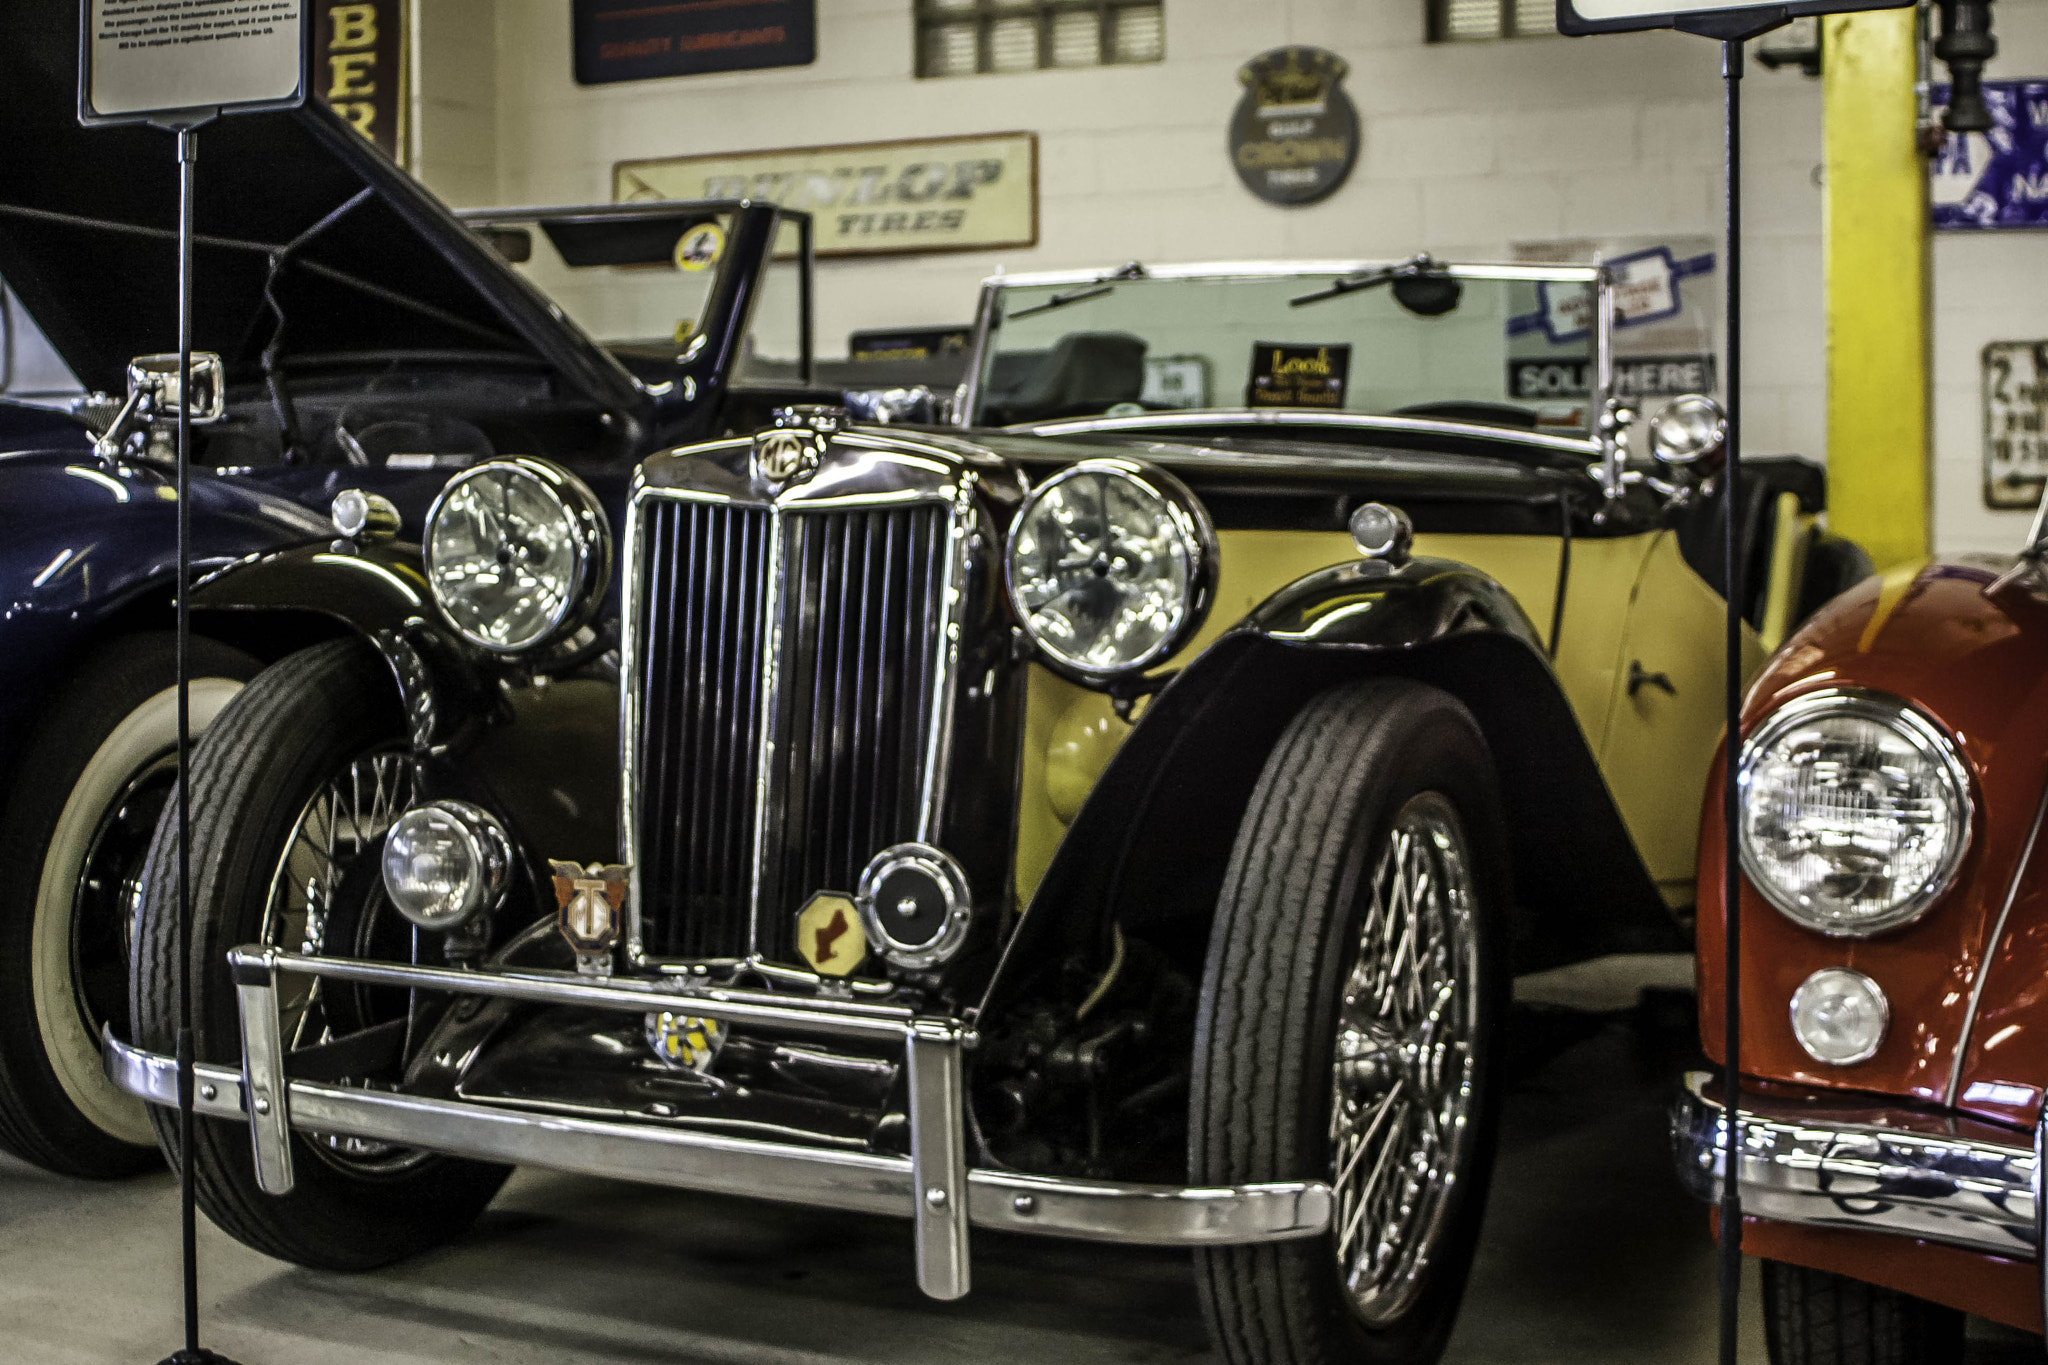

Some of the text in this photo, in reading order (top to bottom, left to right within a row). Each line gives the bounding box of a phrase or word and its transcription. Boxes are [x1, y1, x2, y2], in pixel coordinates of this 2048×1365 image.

[703, 157, 1003, 209] DUNLOP
[837, 208, 967, 237] TIRES
[1519, 364, 1594, 397] SOL
